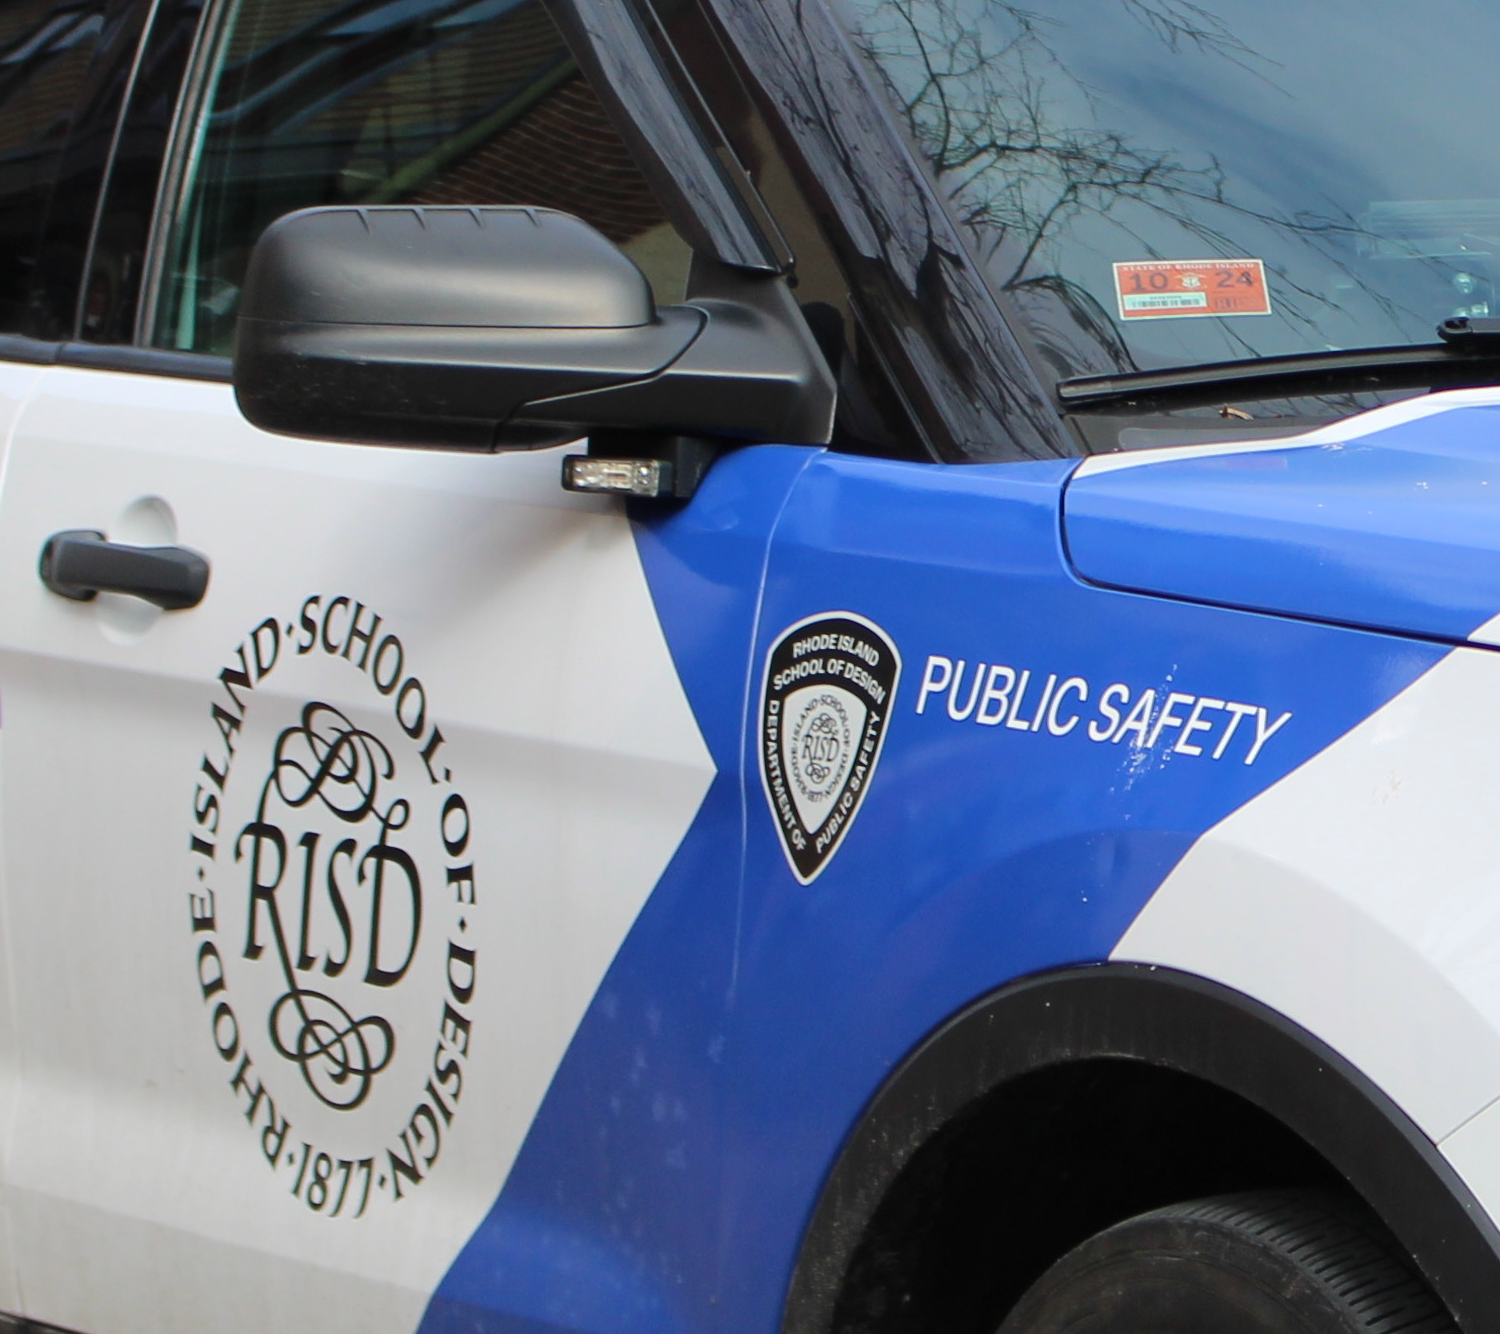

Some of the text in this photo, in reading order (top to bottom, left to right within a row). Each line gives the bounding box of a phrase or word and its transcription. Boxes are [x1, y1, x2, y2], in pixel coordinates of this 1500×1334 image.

[1130, 272, 1169, 291] 10
[1215, 270, 1254, 288] 24
[773, 658, 887, 705] SCHOOL OF DESIGN
[792, 633, 880, 667] RHODE ISLAND
[801, 733, 840, 763] RISD
[915, 654, 1293, 766] PUBLIC SAFETY
[766, 699, 807, 851] DEPARTMENT OF
[815, 710, 881, 854] PUBLIC SAFETY
[189, 594, 477, 1218] RHODE ISLAND SCHOOL OF DESIGN 1877
[234, 821, 422, 988] RISD
